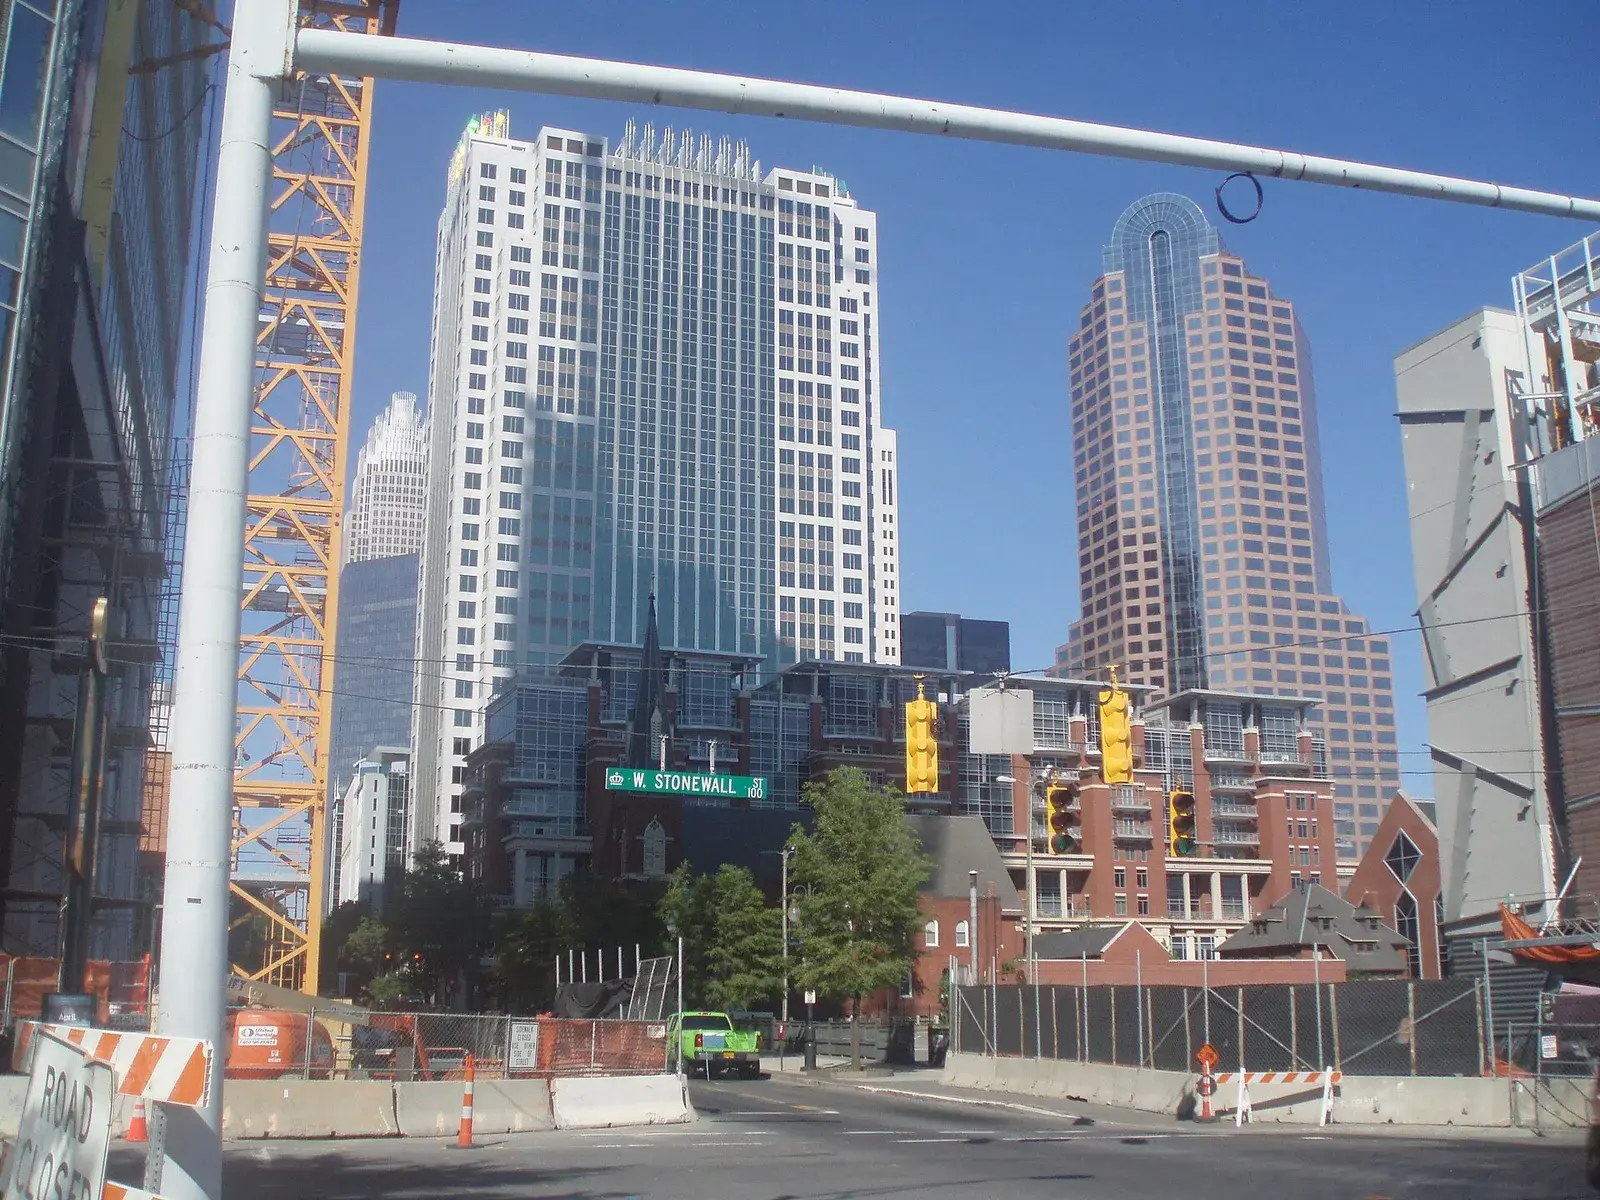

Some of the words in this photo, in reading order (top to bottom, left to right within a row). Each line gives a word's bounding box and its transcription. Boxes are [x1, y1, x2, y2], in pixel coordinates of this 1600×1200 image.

[633, 772, 646, 788] W.
[654, 773, 736, 794] STONEWALL
[752, 778, 763, 788] ST
[747, 787, 763, 799] 100
[59, 1012, 76, 1022] April
[41, 1065, 93, 1144] ROAD
